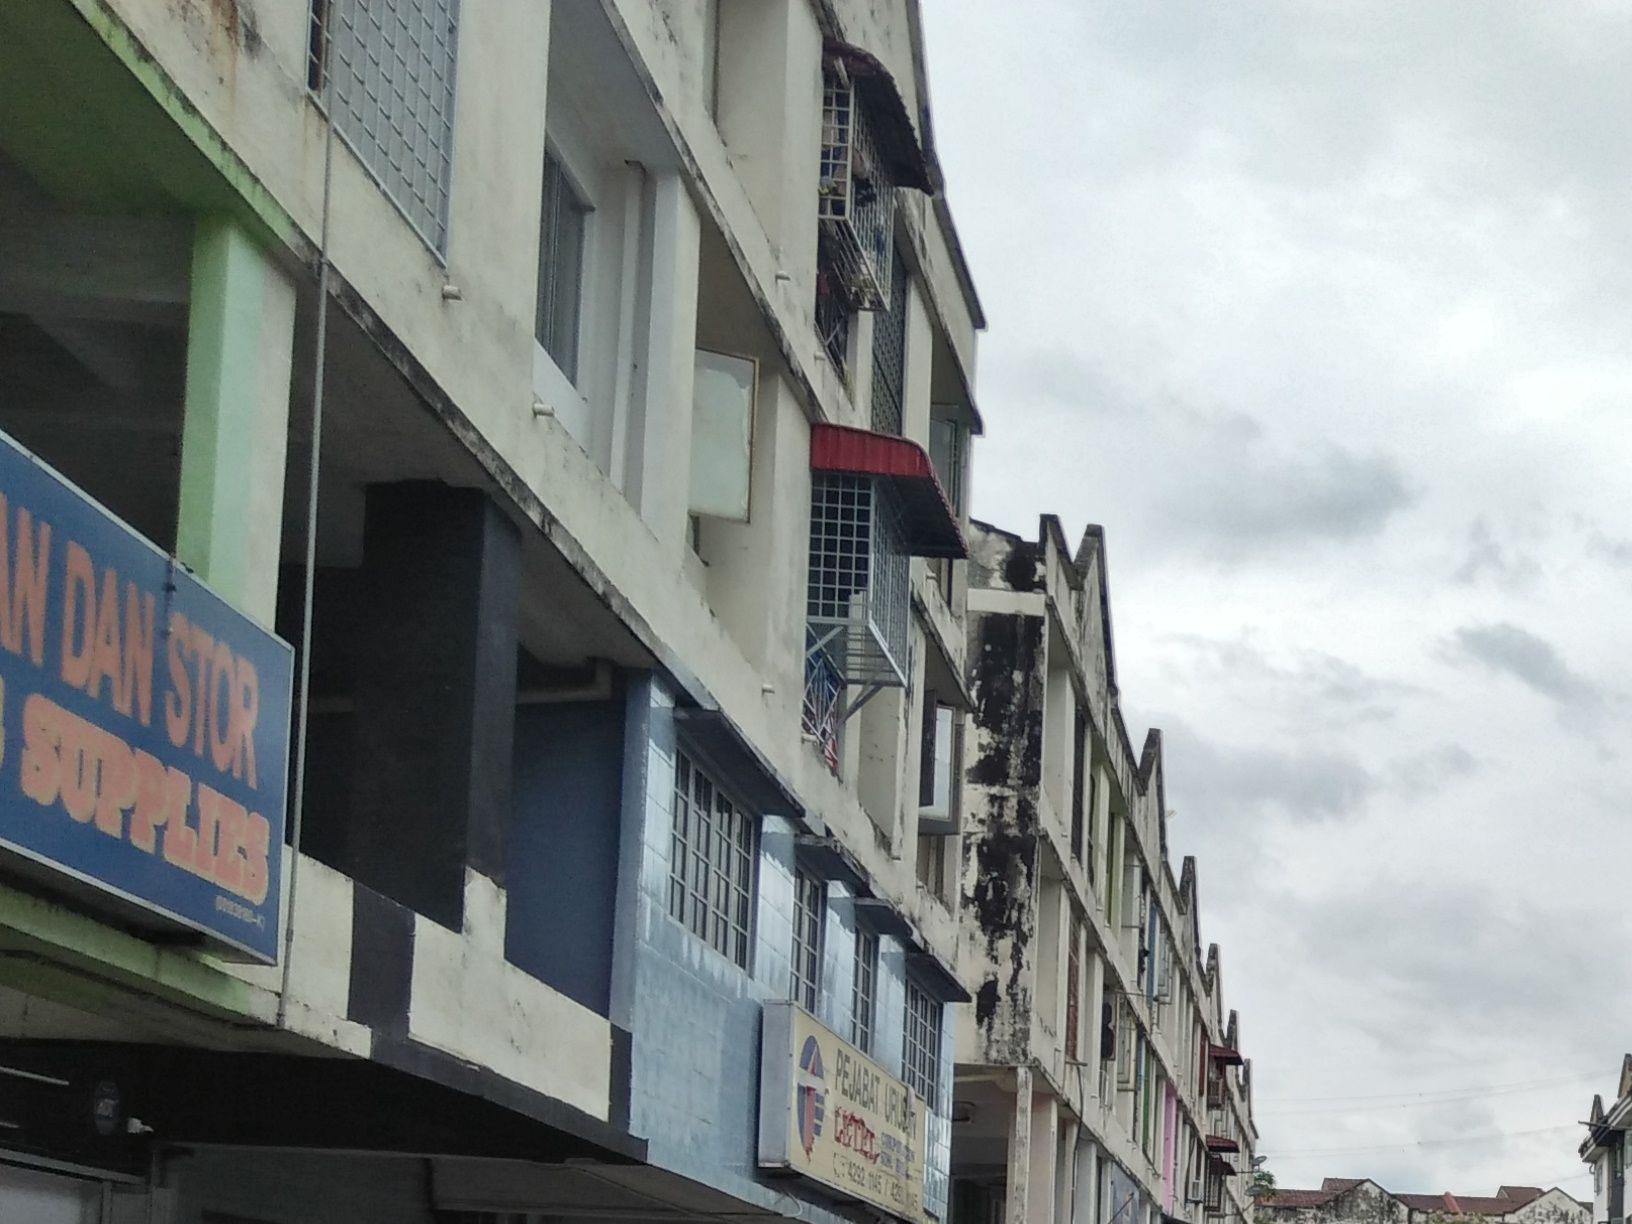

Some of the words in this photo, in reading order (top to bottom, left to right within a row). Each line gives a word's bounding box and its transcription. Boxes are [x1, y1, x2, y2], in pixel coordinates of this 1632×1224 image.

[62, 540, 155, 727] DAN
[165, 612, 259, 789] STOR
[20, 693, 270, 905] SUPPLIES
[834, 1048, 880, 1116] PEJABAT
